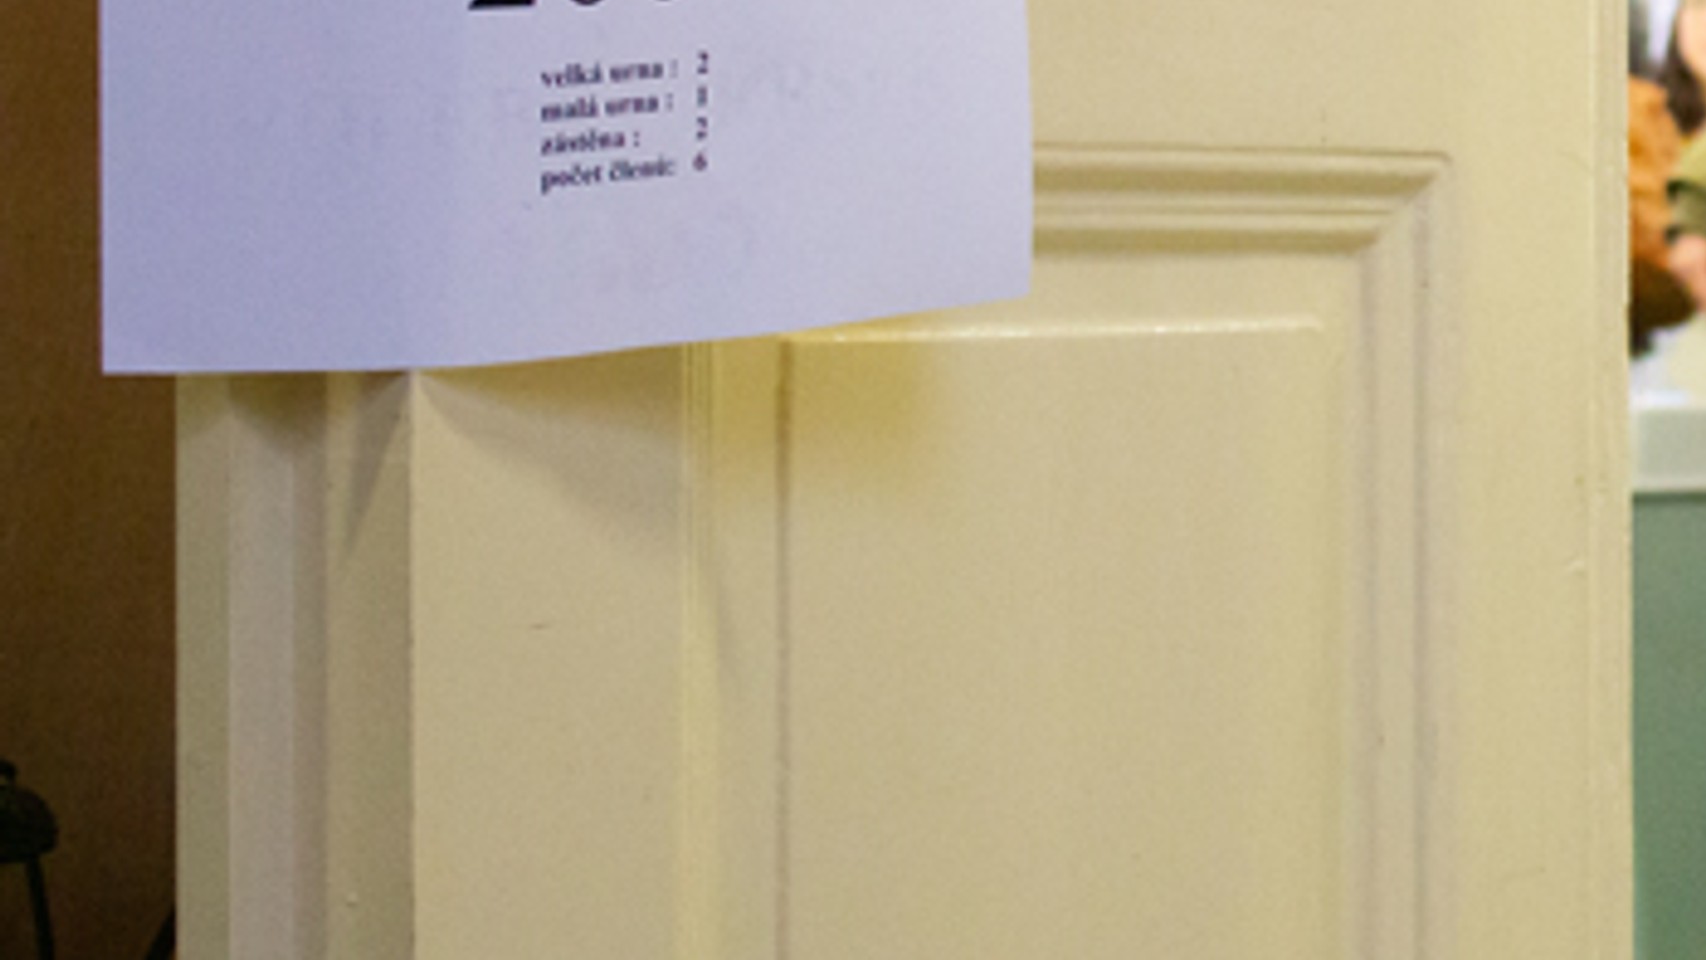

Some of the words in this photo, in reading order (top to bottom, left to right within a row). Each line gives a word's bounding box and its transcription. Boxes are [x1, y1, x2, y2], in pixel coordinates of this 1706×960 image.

[540, 62, 603, 87] velká
[608, 62, 664, 83] urna
[696, 50, 709, 75] 2
[540, 96, 598, 122] malá
[604, 96, 660, 117] urna
[696, 85, 708, 108] 1
[540, 129, 626, 157] zástěna
[696, 116, 709, 141] 2
[540, 163, 602, 196] počet
[692, 151, 709, 172] 6
